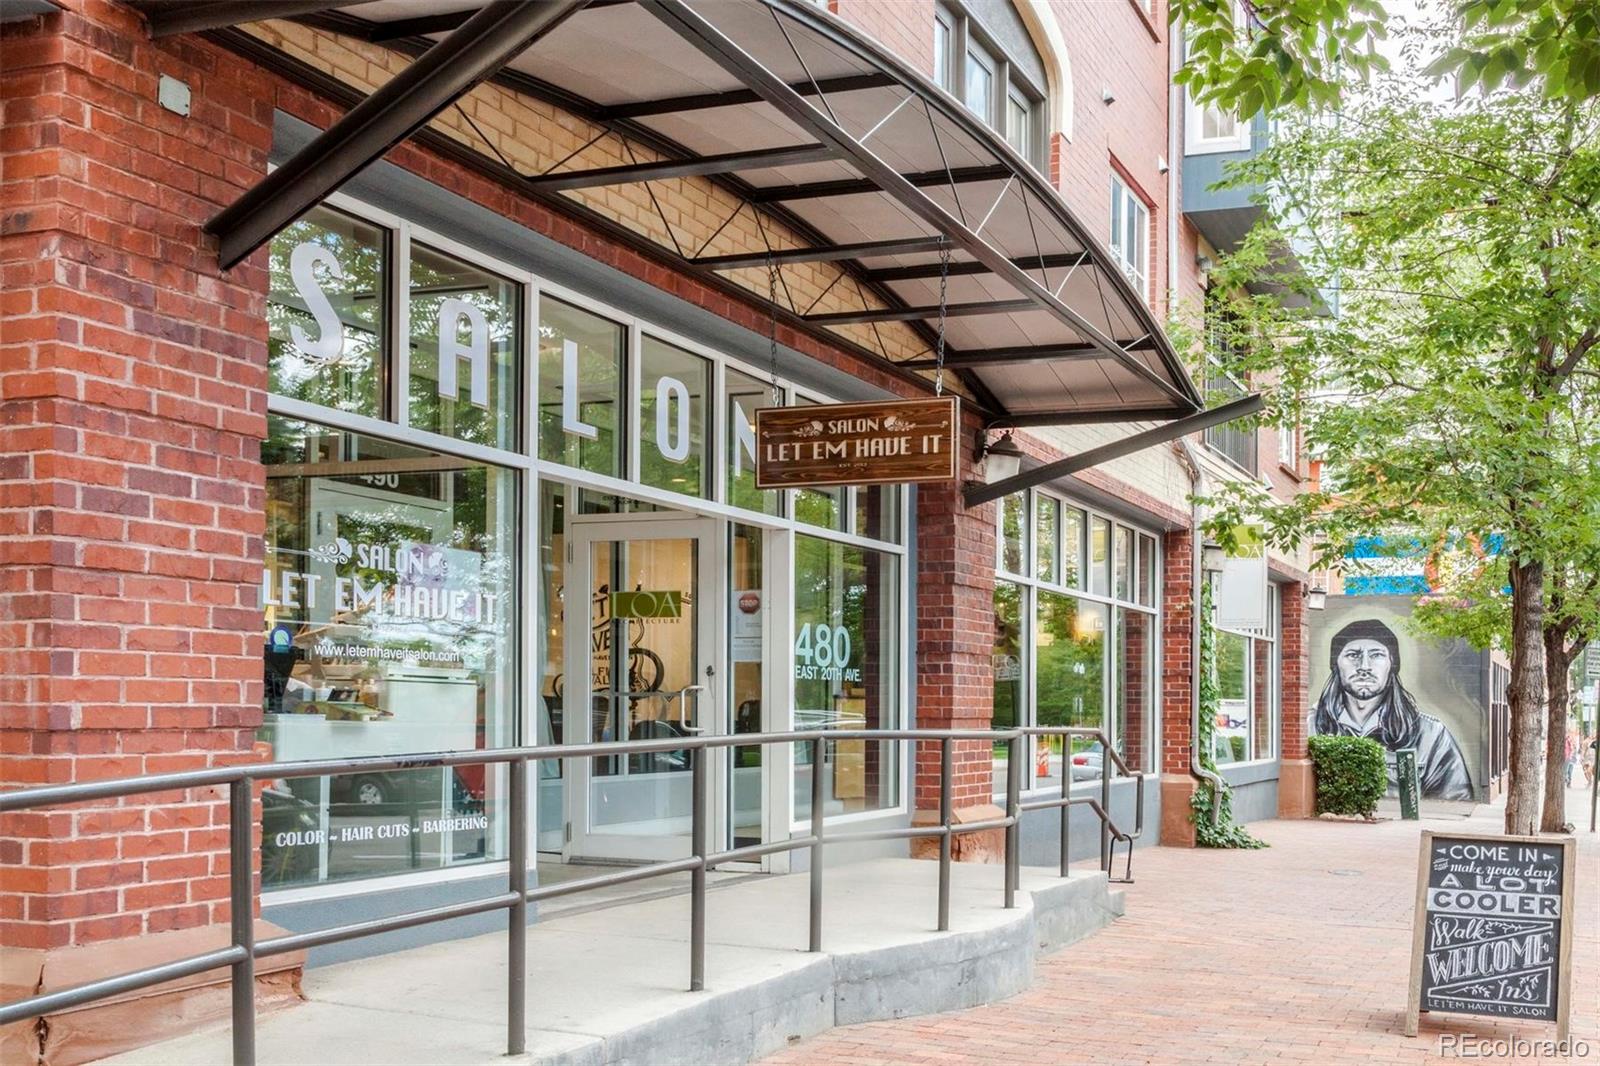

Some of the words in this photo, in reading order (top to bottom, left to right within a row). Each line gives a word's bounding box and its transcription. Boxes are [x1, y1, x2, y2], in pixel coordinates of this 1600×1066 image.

[828, 418, 879, 434] SALON
[767, 443, 801, 462] LET
[812, 440, 847, 460] EM
[855, 436, 912, 458] HAVE
[922, 434, 943, 454] IT
[357, 543, 424, 575] SALON
[263, 569, 321, 609] LET
[335, 576, 384, 616] EM
[394, 584, 468, 621] HAVE
[475, 593, 498, 624] IT
[314, 642, 460, 662] www.letemhaveitsalon.com
[795, 623, 851, 668] 480
[795, 666, 818, 680] EAST
[820, 666, 842, 681] 20TH
[276, 830, 325, 847] COLOR
[341, 826, 374, 842] HAIR
[377, 823, 410, 839] CUTS
[423, 816, 488, 834] BARBERING
[1450, 844, 1509, 862] COME
[1518, 848, 1538, 862] IN
[1440, 873, 1463, 888] A
[1476, 876, 1549, 893] LOT
[1450, 862, 1485, 875] make
[1485, 865, 1521, 883] your
[1523, 863, 1558, 886] day
[1433, 891, 1560, 915] COOLER
[1430, 917, 1488, 945] Walk
[1426, 932, 1554, 986] WELCOME
[1494, 979, 1539, 1001] Ins
[1467, 1003, 1494, 1012] HAVE
[1498, 1005, 1508, 1013] IT
[1512, 1006, 1547, 1016] SALON
